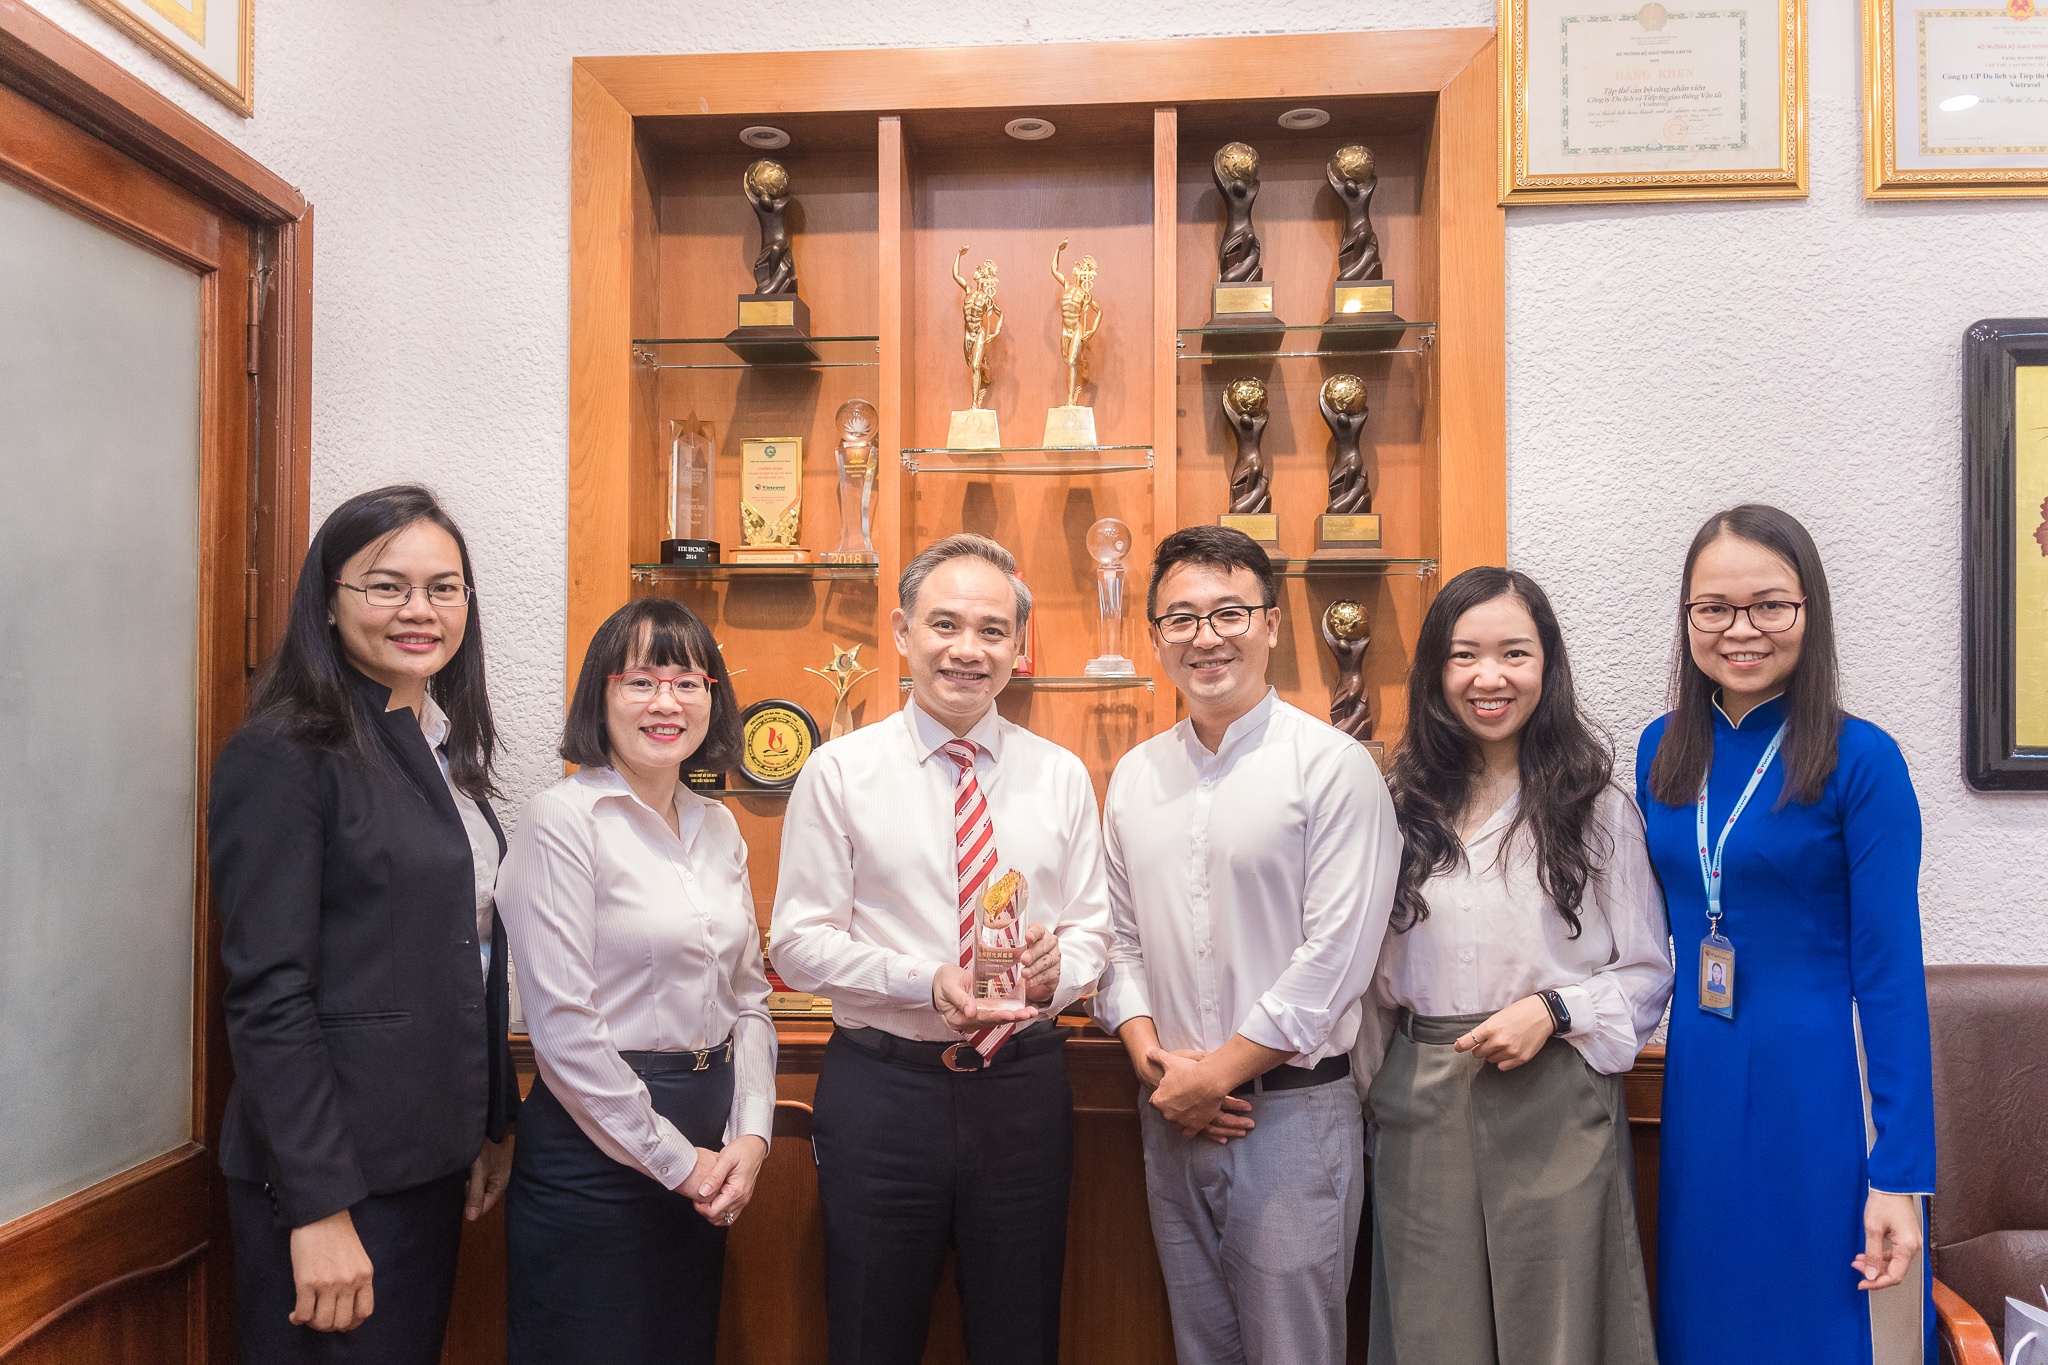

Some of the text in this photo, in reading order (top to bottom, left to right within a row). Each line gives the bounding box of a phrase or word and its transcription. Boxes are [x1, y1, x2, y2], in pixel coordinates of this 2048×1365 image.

[1659, 68, 1695, 79] KHEN
[1962, 73, 1969, 81] ty
[831, 553, 862, 565] 2018
